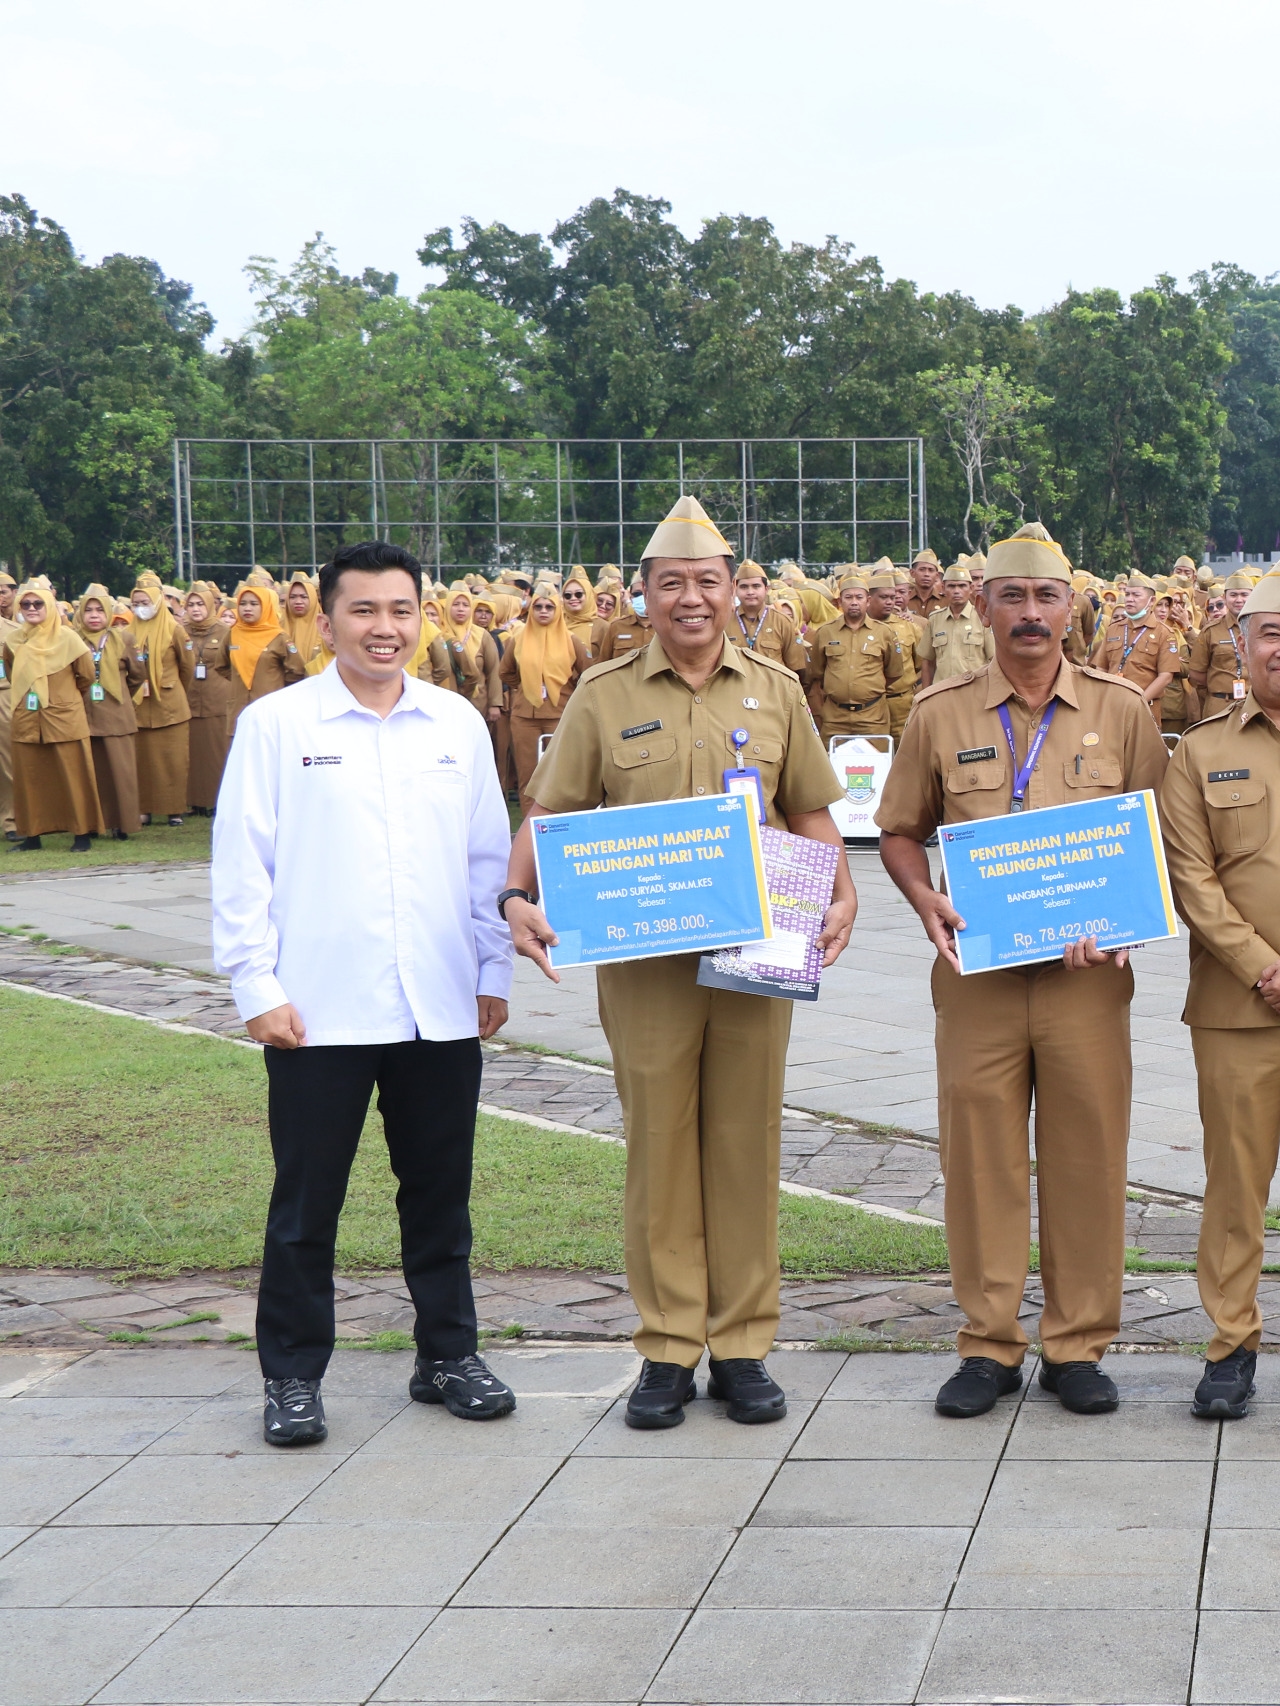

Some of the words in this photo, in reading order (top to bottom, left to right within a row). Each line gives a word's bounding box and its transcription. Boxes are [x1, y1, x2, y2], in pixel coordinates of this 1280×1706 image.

[717, 802, 741, 812] taspen
[1117, 800, 1141, 812] taspen
[848, 813, 869, 823] DPPP
[563, 834, 659, 858] PENYERAHAN
[663, 825, 731, 846] MANFAAT
[969, 835, 1061, 863] PENYERAHAN
[1065, 822, 1131, 846] MANFAAT
[573, 853, 655, 876] TABUNGAN
[658, 848, 693, 865] HARI
[695, 845, 725, 860] TUA
[978, 855, 1057, 880] TABUNGAN
[1060, 848, 1094, 866] HARI
[1095, 842, 1124, 859] TUA
[637, 873, 661, 884] Kepada
[1041, 871, 1065, 882] Kepada
[596, 888, 628, 901] AHMAD
[629, 884, 666, 896] SURYADI,
[1006, 886, 1056, 903] BANGBANG
[1056, 877, 1108, 894] PURNAMA,SP
[637, 897, 666, 908] Sebesar
[1043, 898, 1071, 909] Sebesar
[606, 925, 630, 942] Rp.
[632, 914, 715, 936] 79.398.000,-
[1013, 932, 1037, 949] Rp.
[1038, 918, 1118, 943] 78.422.000,-
